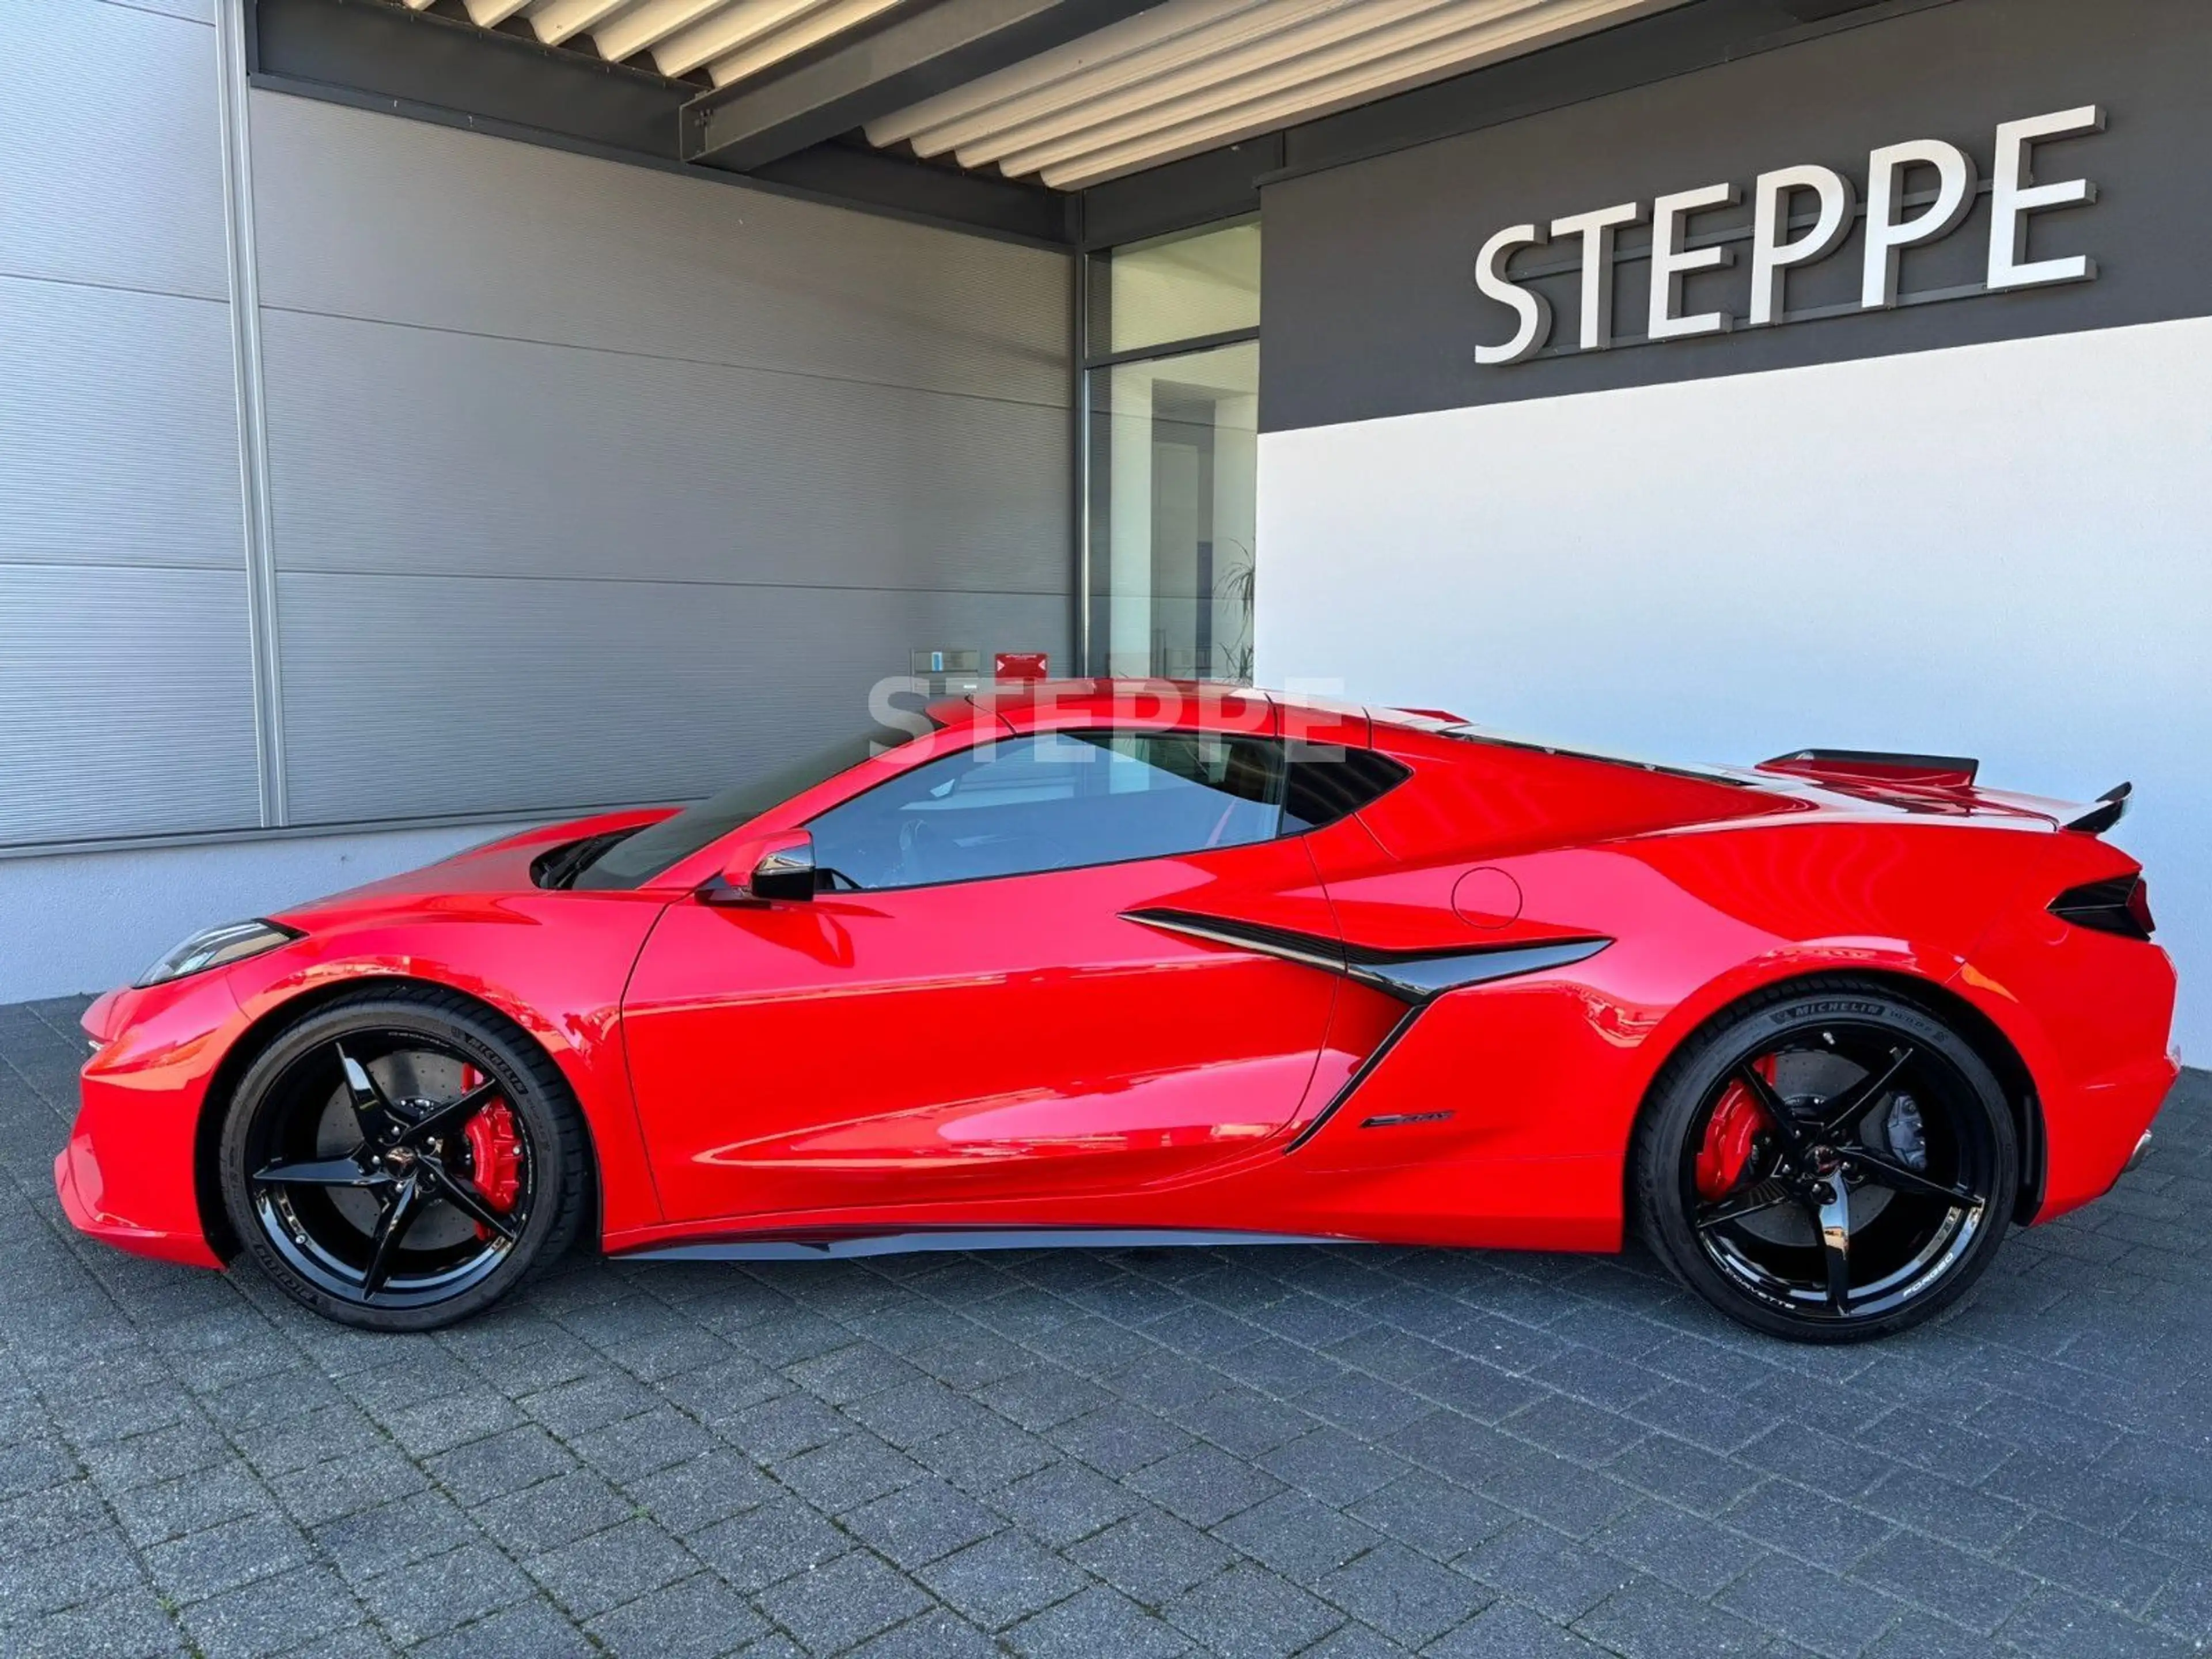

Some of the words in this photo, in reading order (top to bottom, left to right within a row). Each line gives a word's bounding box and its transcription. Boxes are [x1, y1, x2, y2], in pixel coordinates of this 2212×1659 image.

[1474, 105, 2104, 365] STEPPE
[1794, 1001, 1880, 1016] MICHELIN
[467, 1037, 524, 1093] MICHELIN
